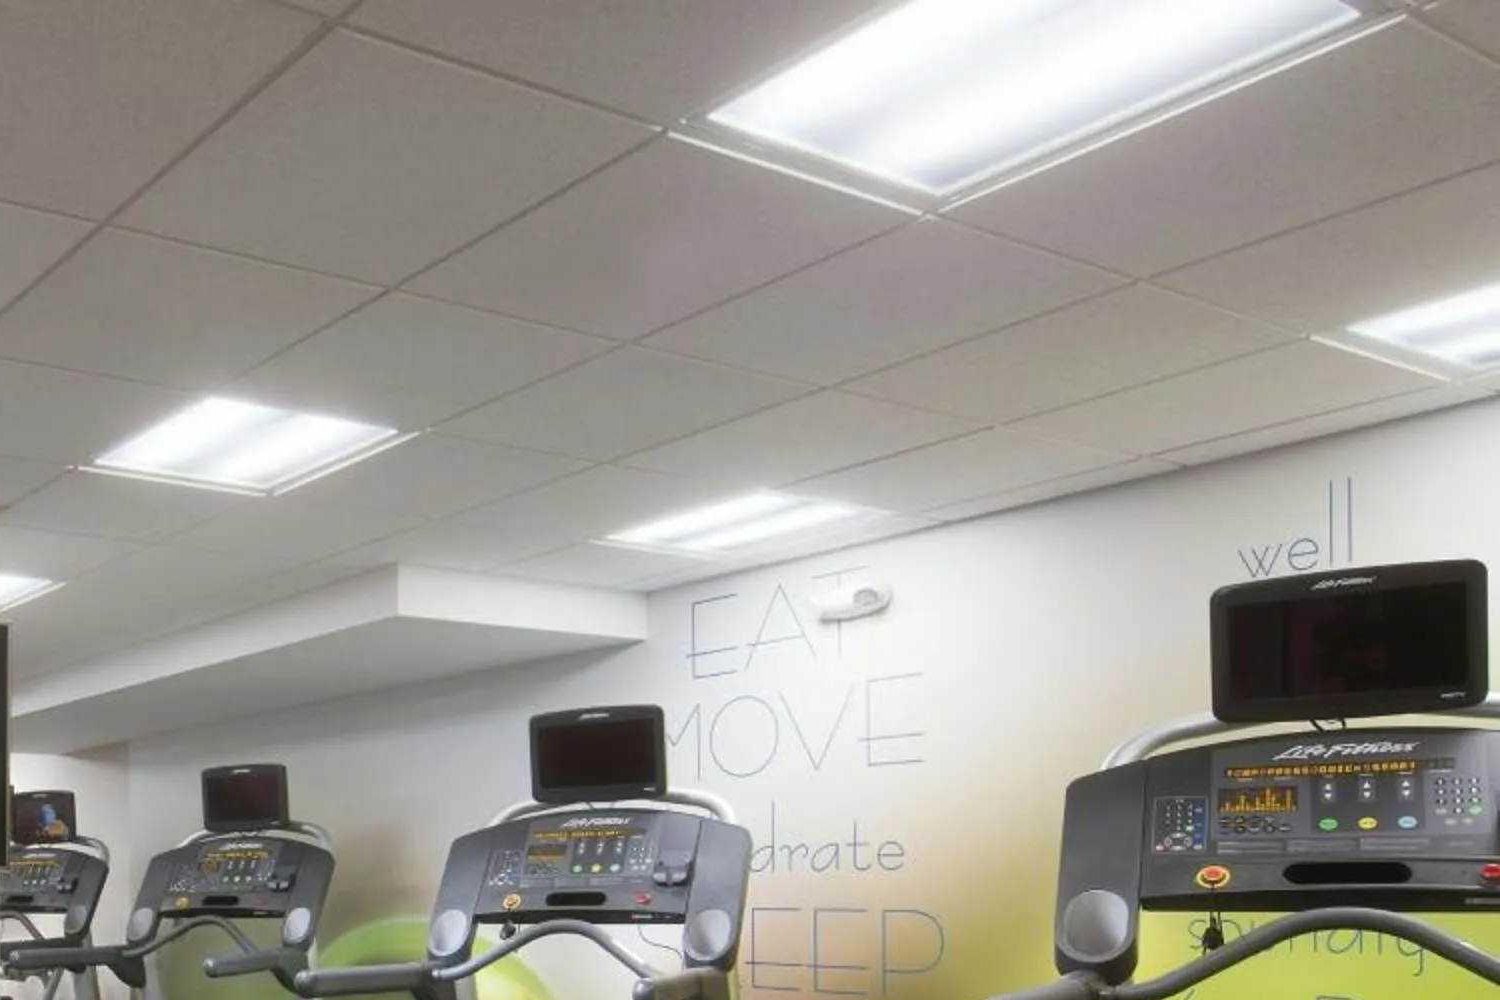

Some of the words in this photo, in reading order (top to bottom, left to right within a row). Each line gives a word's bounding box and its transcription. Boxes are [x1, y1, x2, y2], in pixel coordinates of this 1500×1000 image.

[685, 565, 870, 680] EAT
[1237, 475, 1352, 578] well
[749, 800, 905, 873] drate
